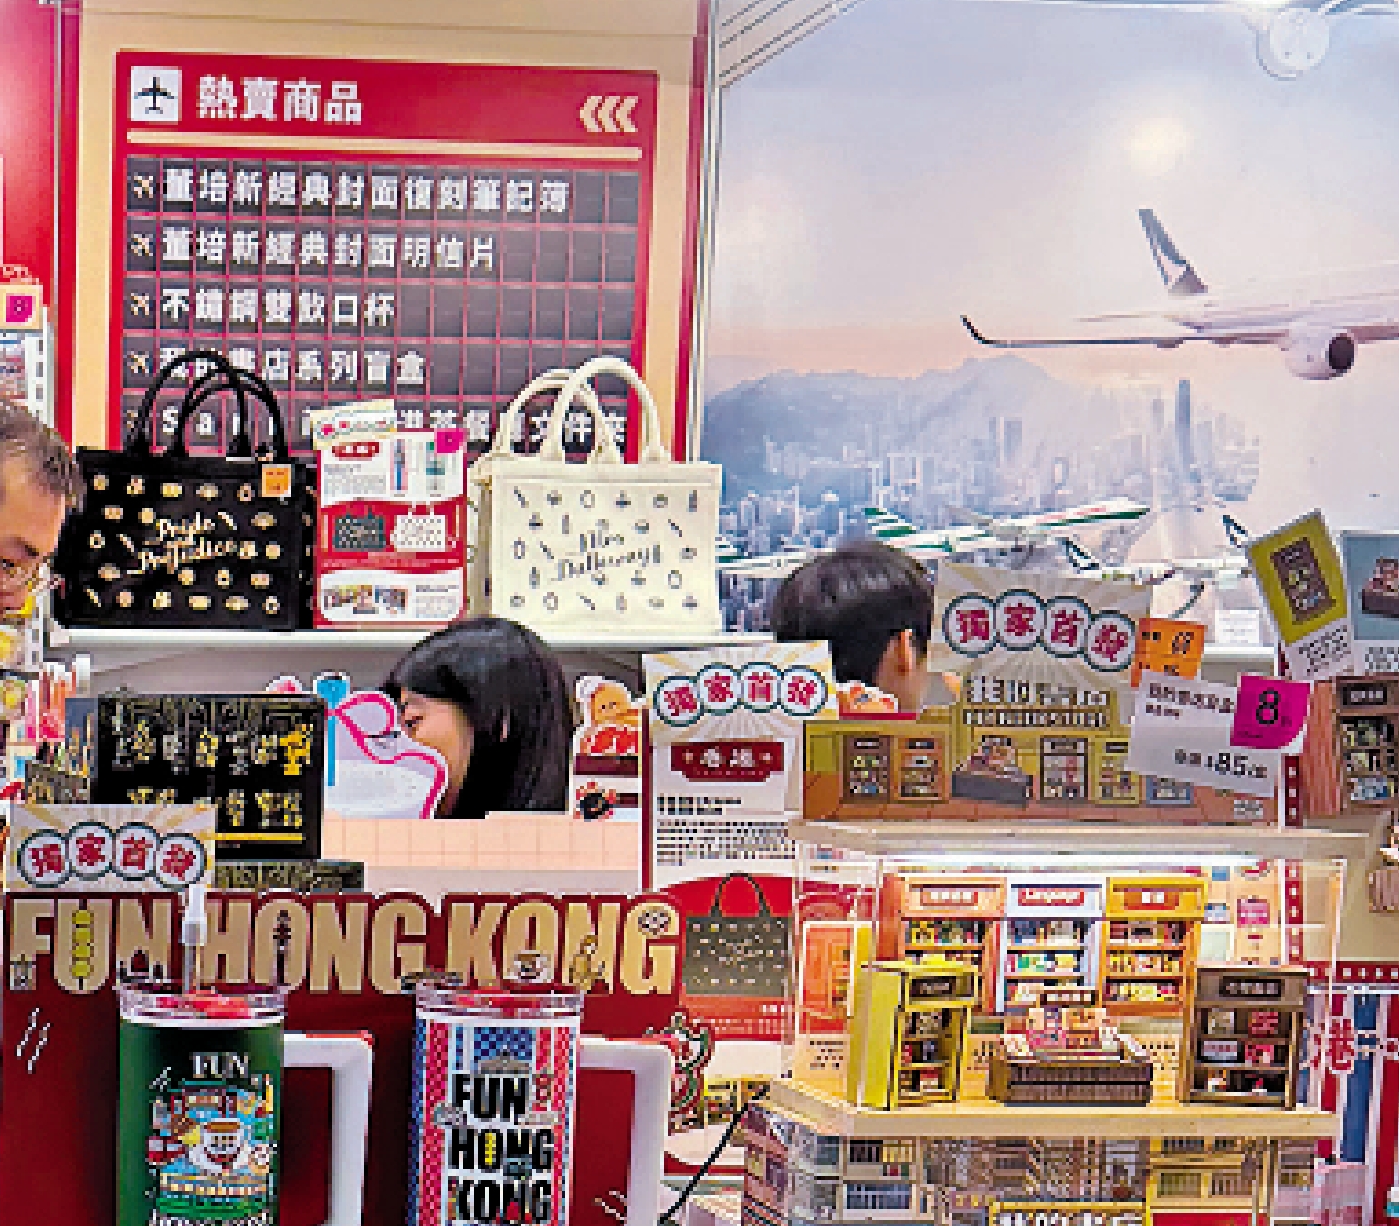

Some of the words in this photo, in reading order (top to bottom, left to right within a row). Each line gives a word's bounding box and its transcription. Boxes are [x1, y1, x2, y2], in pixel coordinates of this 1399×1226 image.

[197, 75, 364, 124] 熱賣商品
[1255, 685, 1280, 725] 8
[9, 898, 173, 994] FUN
[204, 897, 428, 996] HONG
[442, 897, 680, 996] KONG
[190, 1051, 250, 1079] FUN
[452, 1073, 529, 1123] FUN
[448, 1128, 555, 1173] HONG
[448, 1178, 552, 1225] KONG
